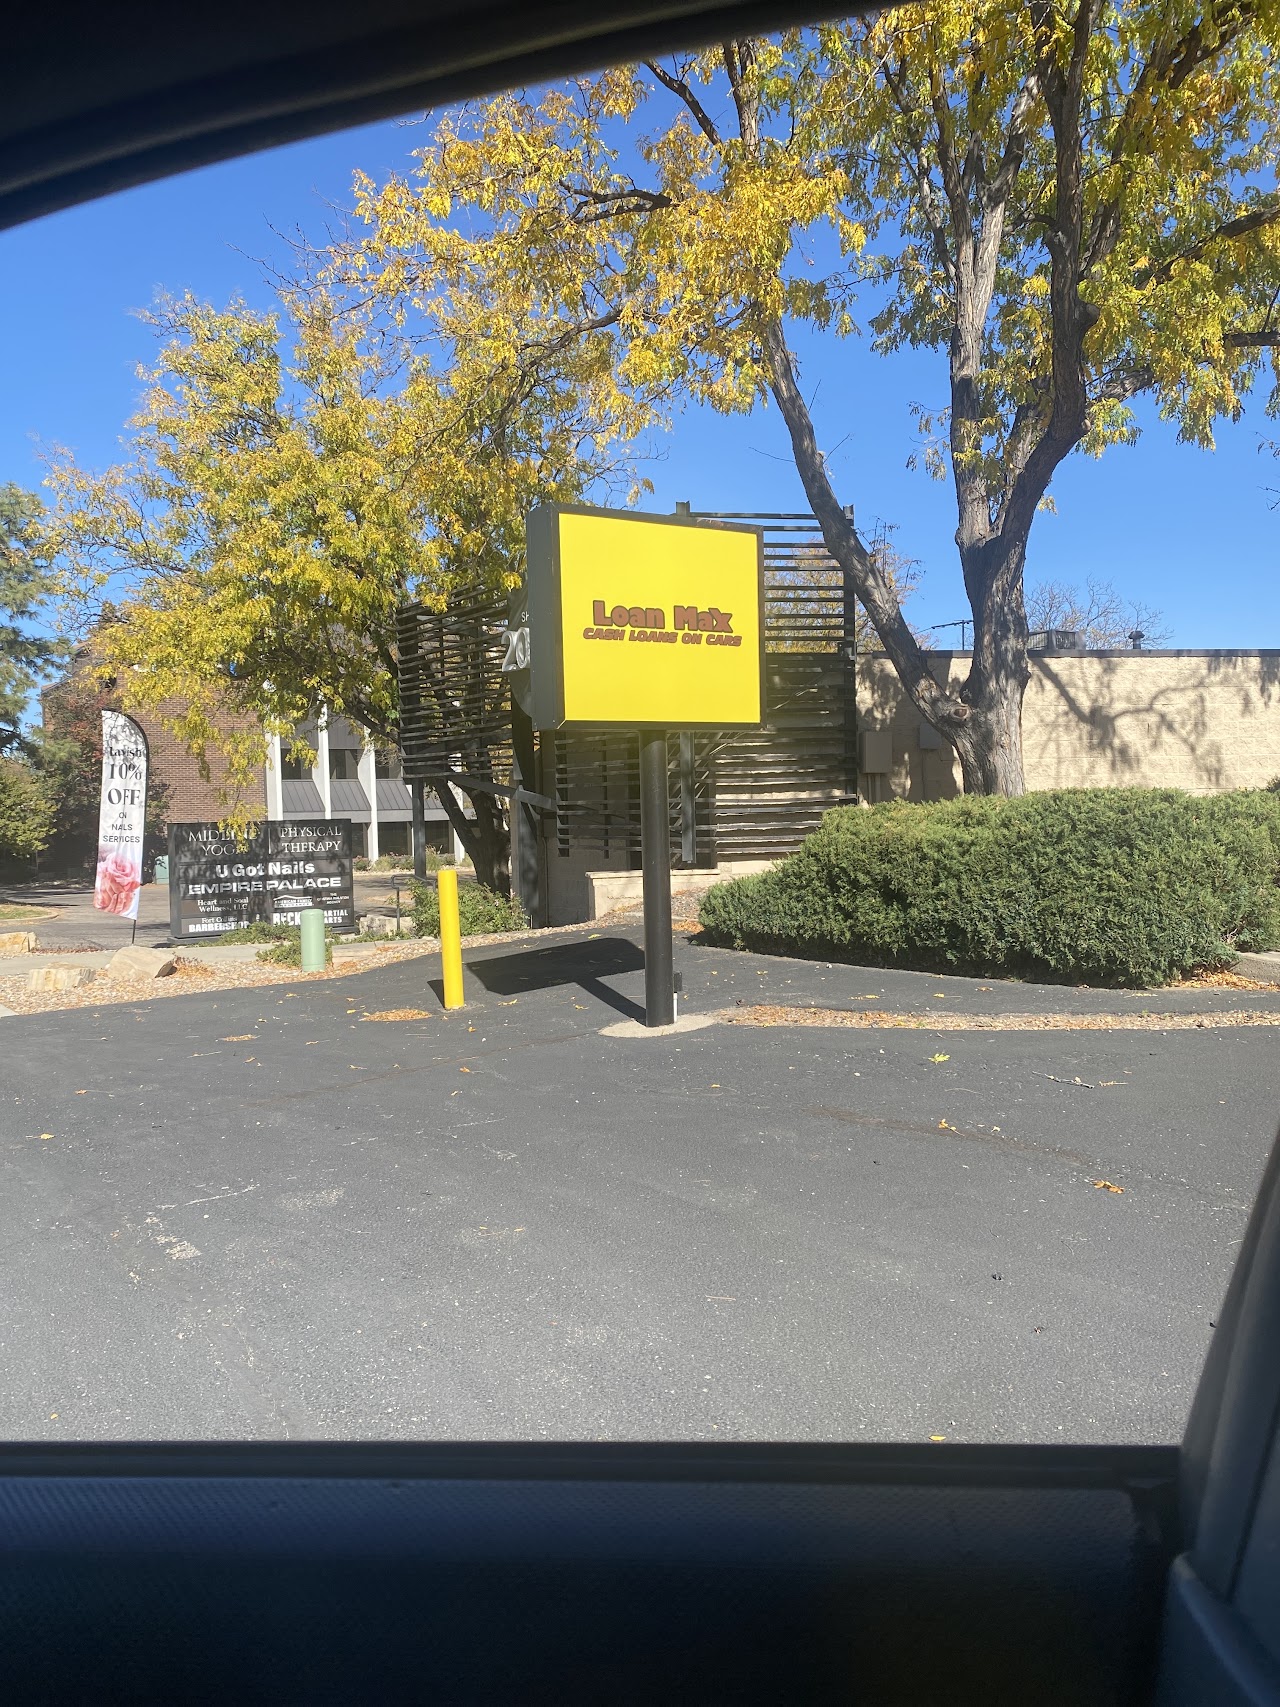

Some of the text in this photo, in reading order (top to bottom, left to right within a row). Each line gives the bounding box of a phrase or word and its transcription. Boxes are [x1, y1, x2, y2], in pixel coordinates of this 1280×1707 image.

[592, 600, 733, 633] Loan Max
[582, 627, 743, 647] CASH LOANS ON CARS
[109, 763, 142, 780] 10%
[107, 788, 141, 805] OFF
[280, 825, 342, 838] PHYSICAL
[201, 843, 243, 856] YOG
[281, 840, 341, 853] THERAPY
[215, 861, 315, 878] U Got Nails
[188, 877, 342, 895] EMPIRE PALACE
[323, 909, 349, 917] ARTIAL
[323, 916, 343, 924] ARTS
[188, 921, 250, 933] BARBERSHOP
